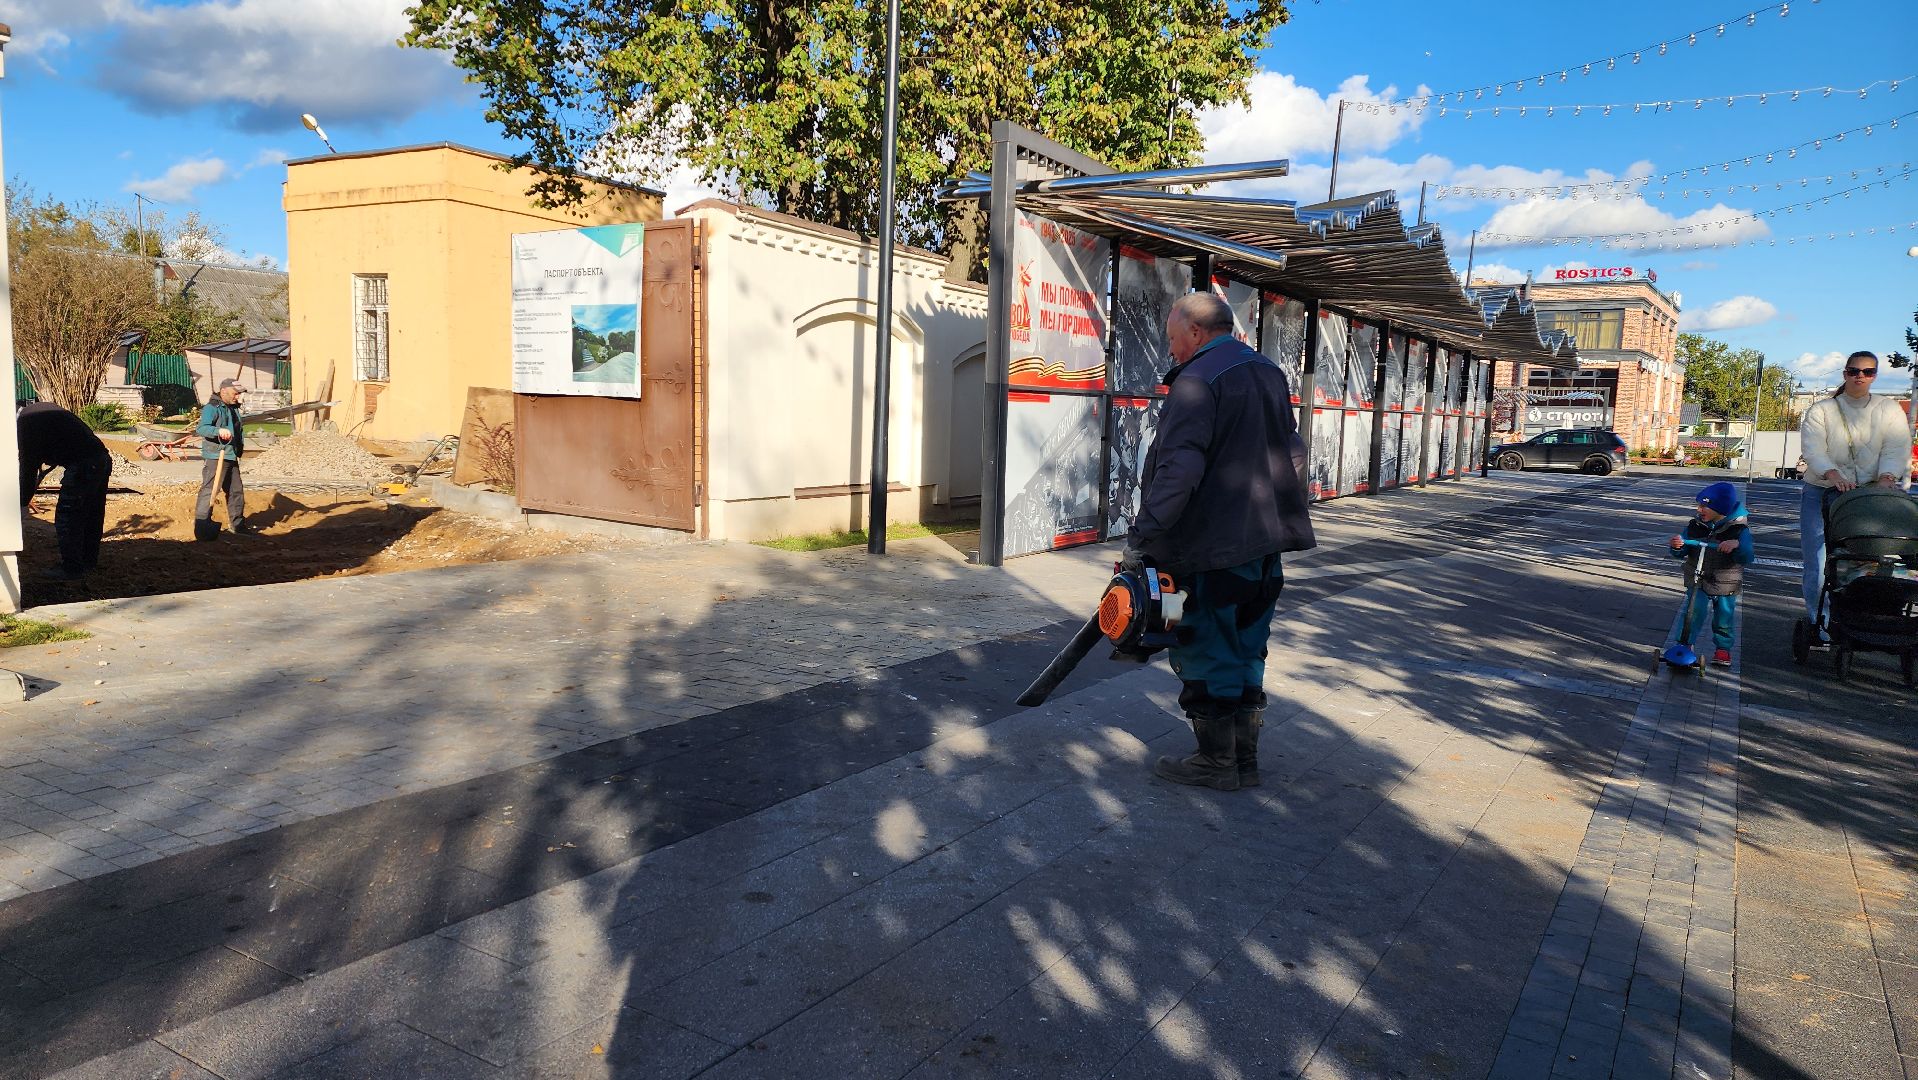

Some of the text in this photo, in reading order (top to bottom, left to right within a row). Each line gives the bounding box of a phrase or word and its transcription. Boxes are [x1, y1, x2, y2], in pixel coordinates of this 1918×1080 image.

[544, 268, 604, 278] ПАСПОРТ ОБЪЕКТА
[1555, 267, 1633, 279] ROSTIC'S
[1041, 282, 1056, 304] МЫ
[1040, 309, 1056, 331] МЫ
